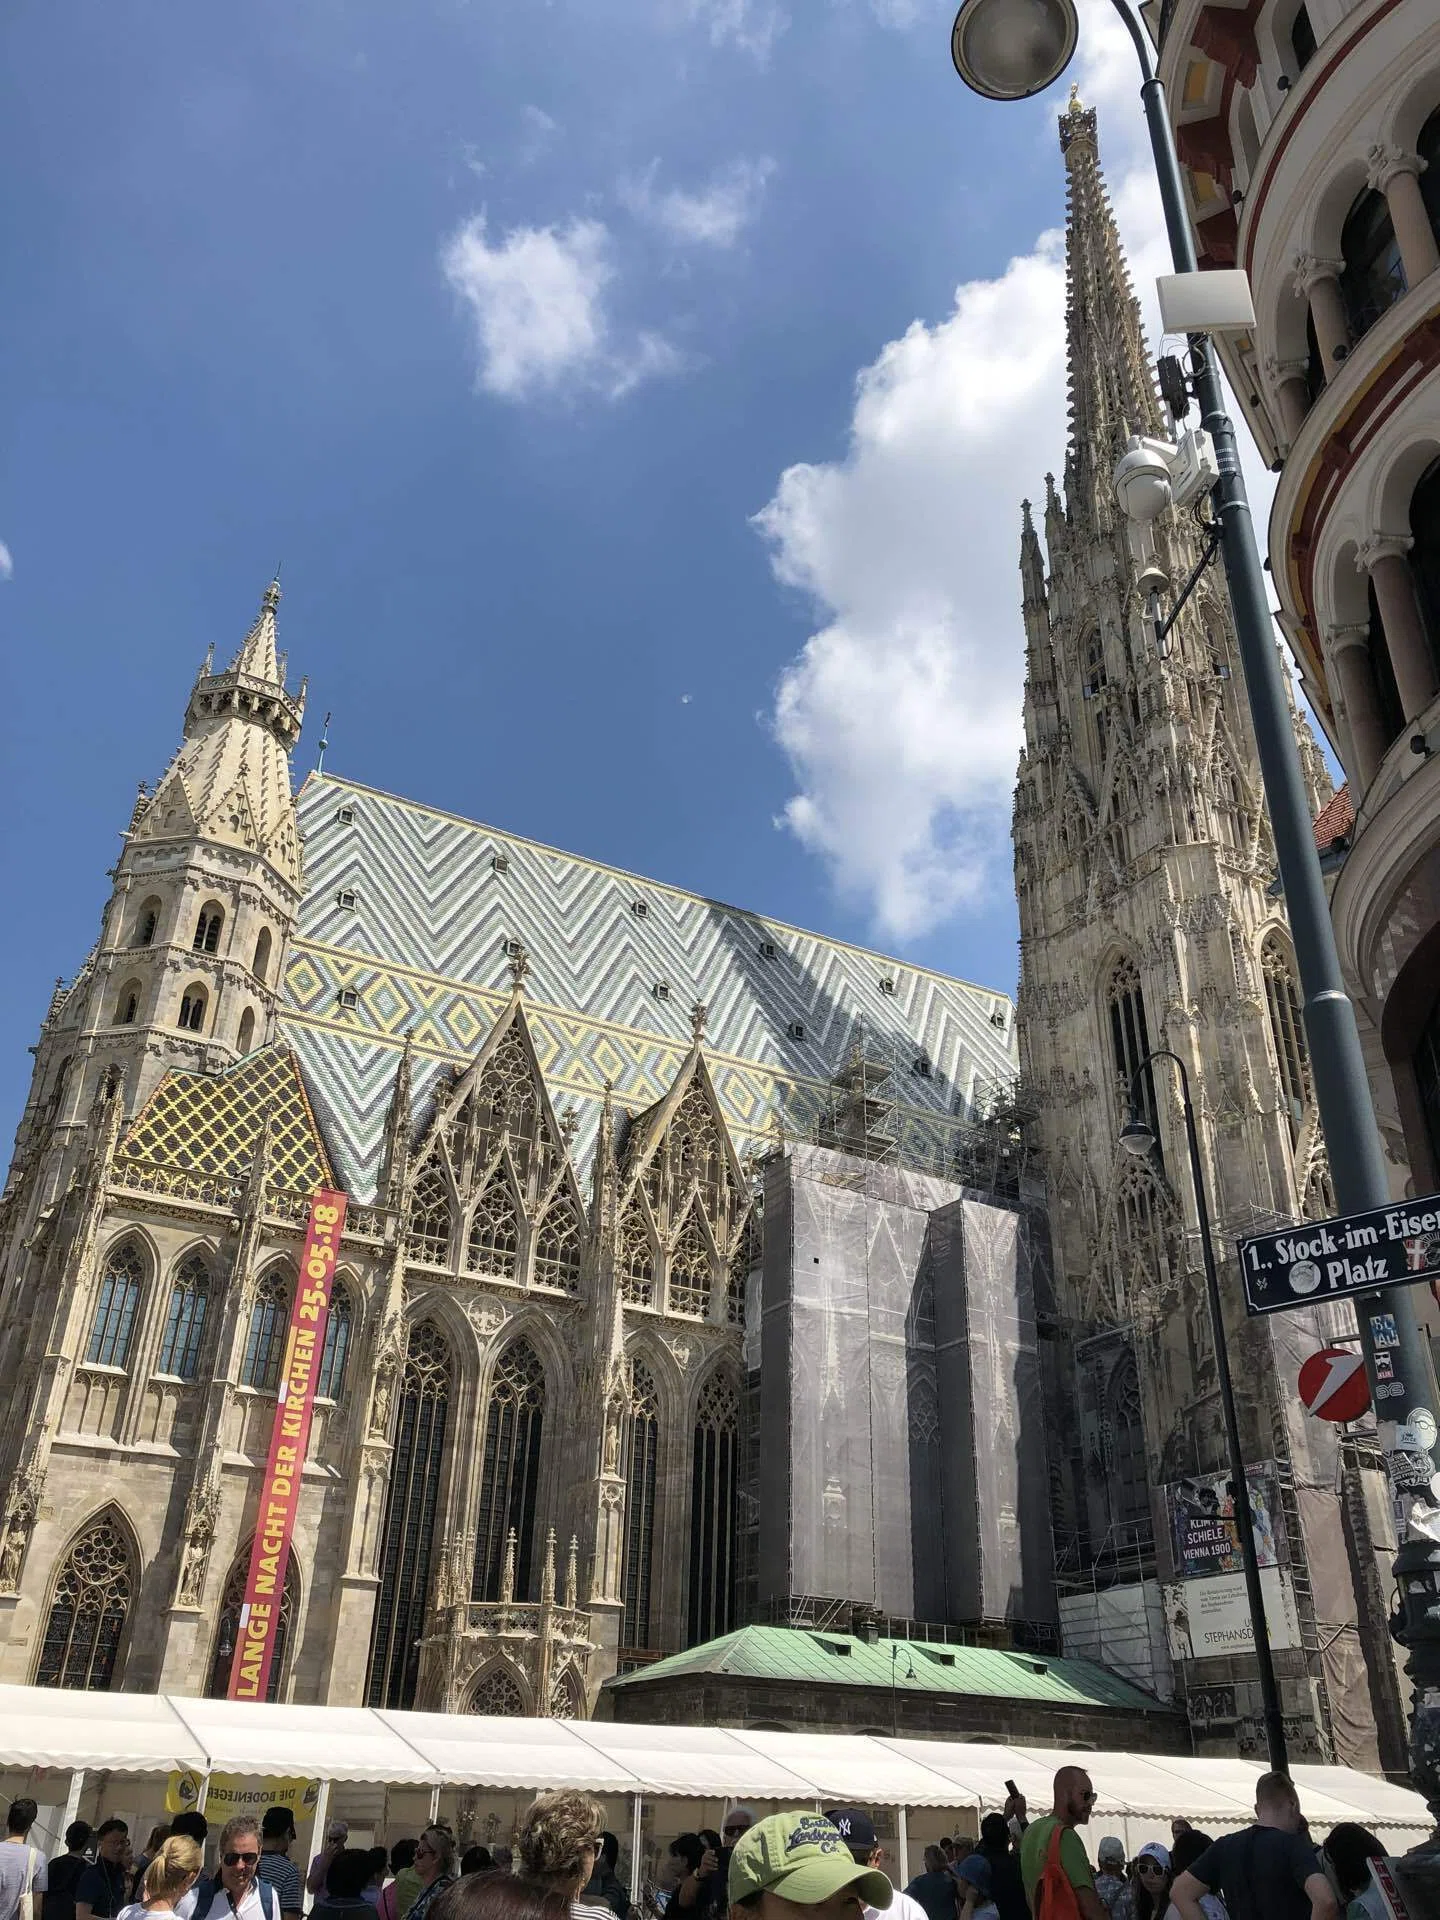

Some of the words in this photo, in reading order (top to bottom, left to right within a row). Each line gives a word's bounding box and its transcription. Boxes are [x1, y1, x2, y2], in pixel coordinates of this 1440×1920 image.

[299, 1204, 339, 1322] 25.05.18
[1275, 1209, 1440, 1265] Stock-im-Eise
[1326, 1254, 1389, 1289] Platz
[281, 1328, 316, 1438] KIRCHEN
[271, 1445, 297, 1497] DER
[254, 1502, 288, 1595] NACHT
[1183, 1545, 1211, 1560] VIENNA
[1211, 1542, 1231, 1556] 1900
[1187, 1527, 1223, 1545] SCHIELE
[236, 1603, 272, 1697] LANGE
[1204, 1626, 1272, 1644] STEPHANSD
